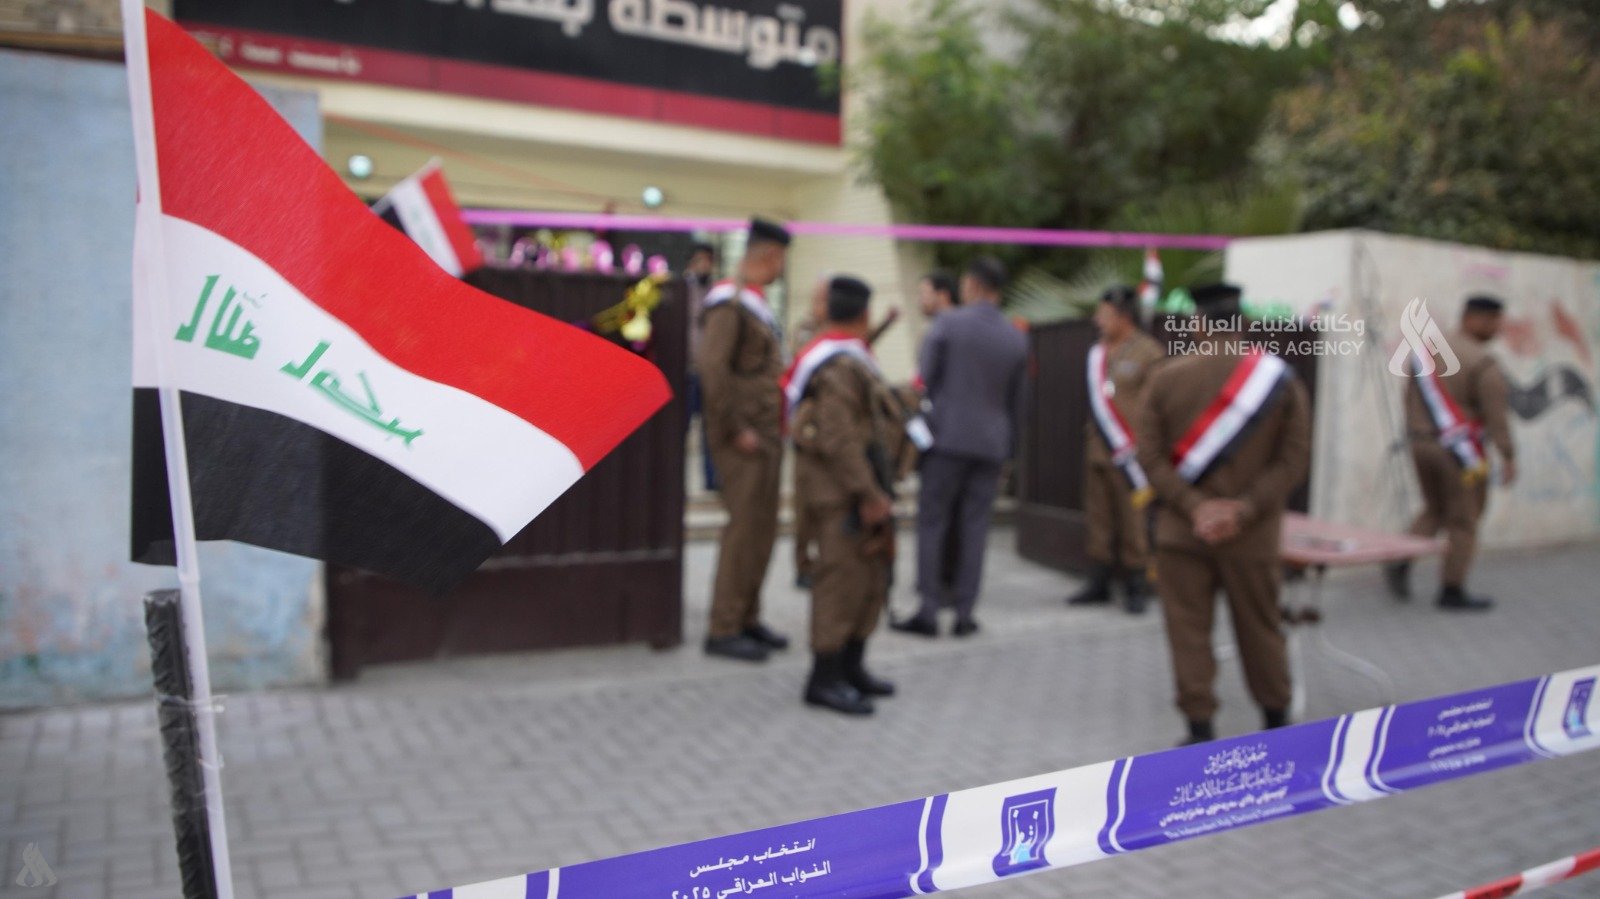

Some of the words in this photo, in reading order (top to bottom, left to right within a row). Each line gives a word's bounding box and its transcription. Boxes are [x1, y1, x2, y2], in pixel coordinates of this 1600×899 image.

[753, 838, 816, 864] انتخاب
[689, 854, 749, 878] مجلس
[781, 860, 831, 885] النواب
